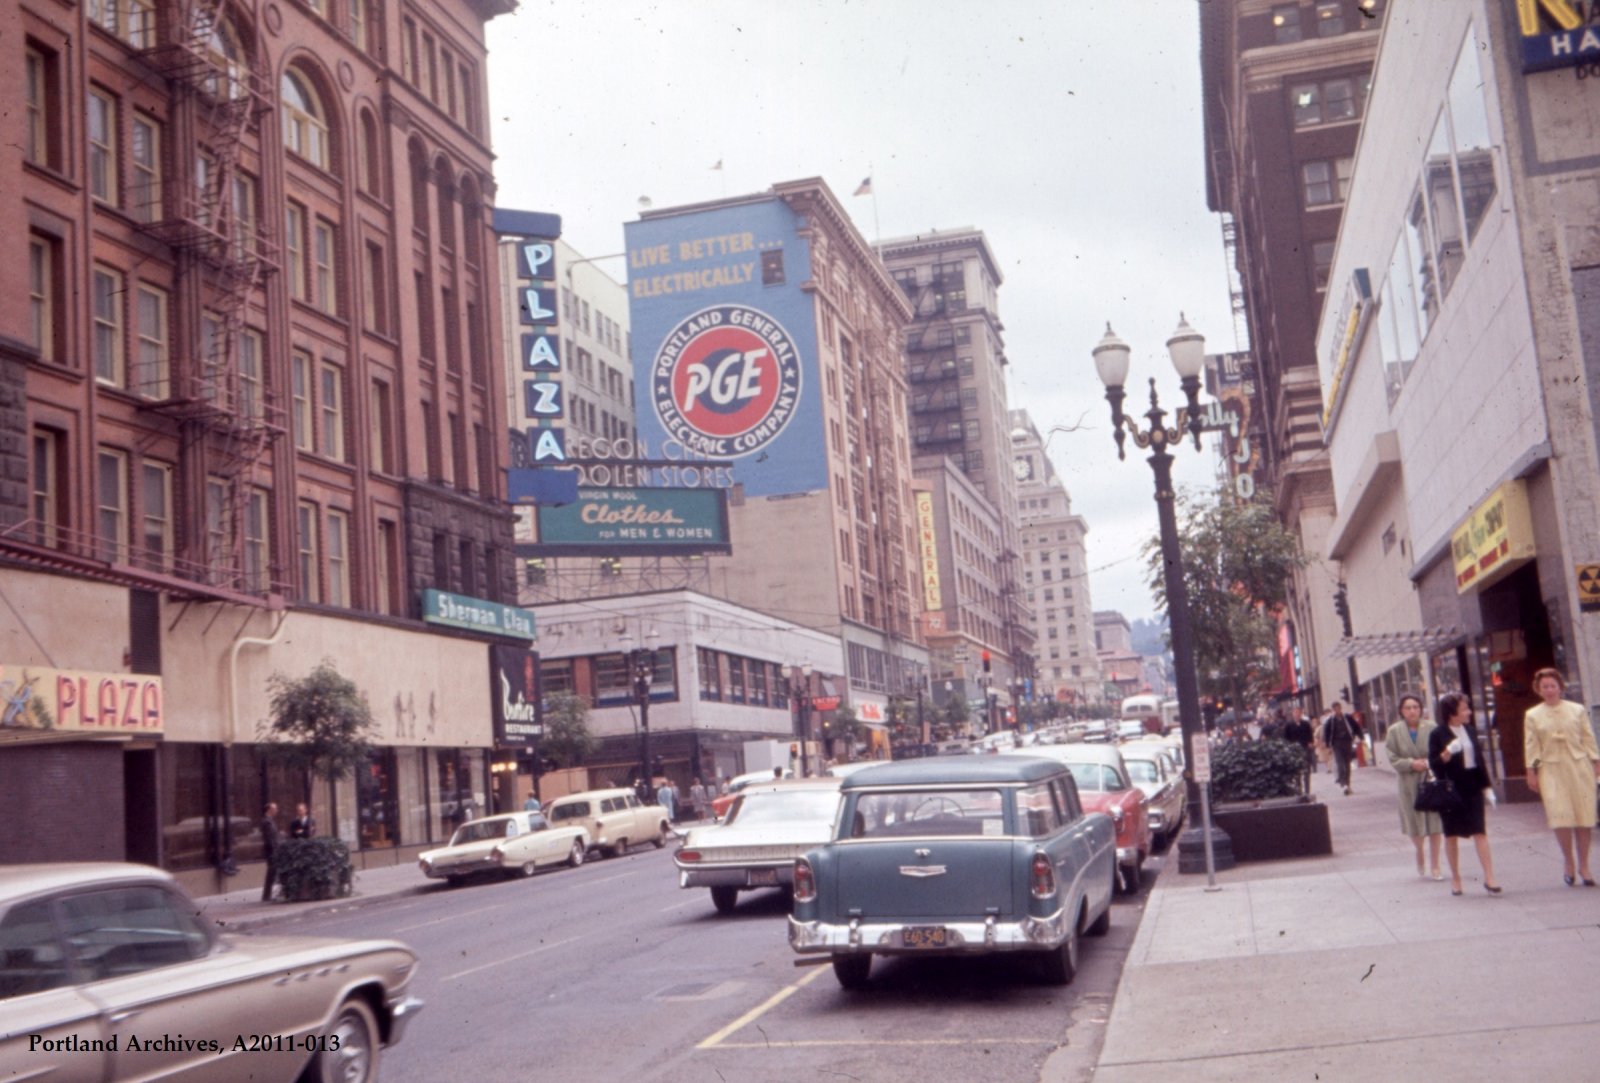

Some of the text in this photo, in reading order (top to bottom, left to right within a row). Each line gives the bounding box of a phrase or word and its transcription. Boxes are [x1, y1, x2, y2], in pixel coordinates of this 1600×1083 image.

[631, 244, 671, 268] LIVE
[633, 262, 755, 298] ELECTRICALLY
[525, 243, 565, 461] PLAZA
[657, 309, 789, 377] PORTLAND GENERAL
[684, 348, 768, 412] PGE
[658, 383, 796, 454] ELECTRIC COMPANY
[1192, 403, 1240, 438] olly
[565, 437, 648, 459] REGON
[562, 464, 734, 488] OOLEN STORES
[611, 491, 638, 500] WOOL
[581, 503, 685, 523] Clothes
[620, 528, 647, 538] MEN
[653, 528, 661, 538] &
[666, 528, 713, 538] WOMEN
[920, 501, 937, 601] GENERAL
[438, 593, 496, 625] Sherman
[56, 675, 160, 727] PLAZA
[505, 724, 542, 734] RESTAURANT
